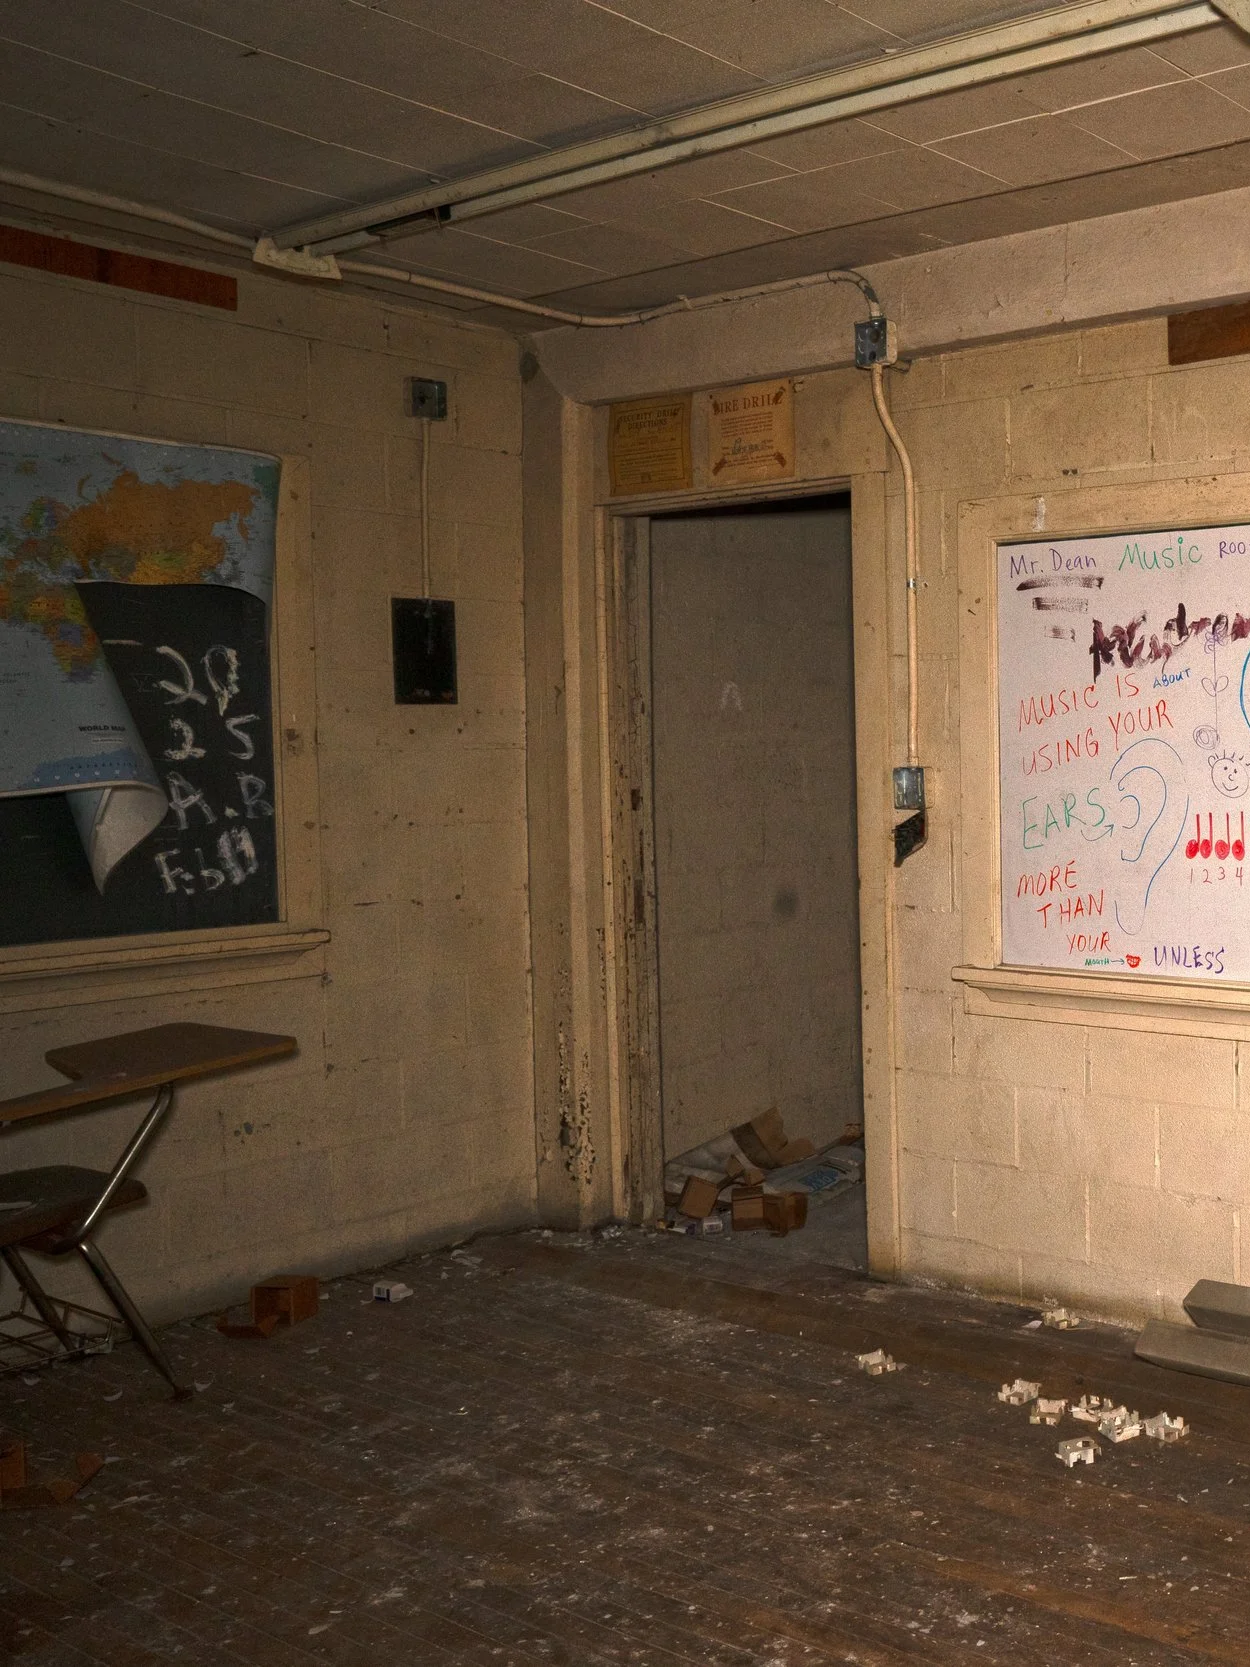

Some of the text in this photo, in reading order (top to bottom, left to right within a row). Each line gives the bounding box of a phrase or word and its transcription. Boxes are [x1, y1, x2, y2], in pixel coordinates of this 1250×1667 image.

[1010, 548, 1097, 578] Mr. Dean
[1119, 536, 1203, 571] Music
[1018, 672, 1140, 733] MUSIC IS
[1022, 699, 1174, 777] USING YOUR
[1022, 787, 1106, 850] EARS
[1017, 860, 1077, 898] MORE
[1202, 869, 1213, 885] 2
[1217, 866, 1227, 882] 3
[1234, 866, 1244, 887] 4
[1037, 889, 1104, 929] THAN
[1066, 931, 1111, 955] YOUR
[1154, 945, 1225, 974] UNLESS
